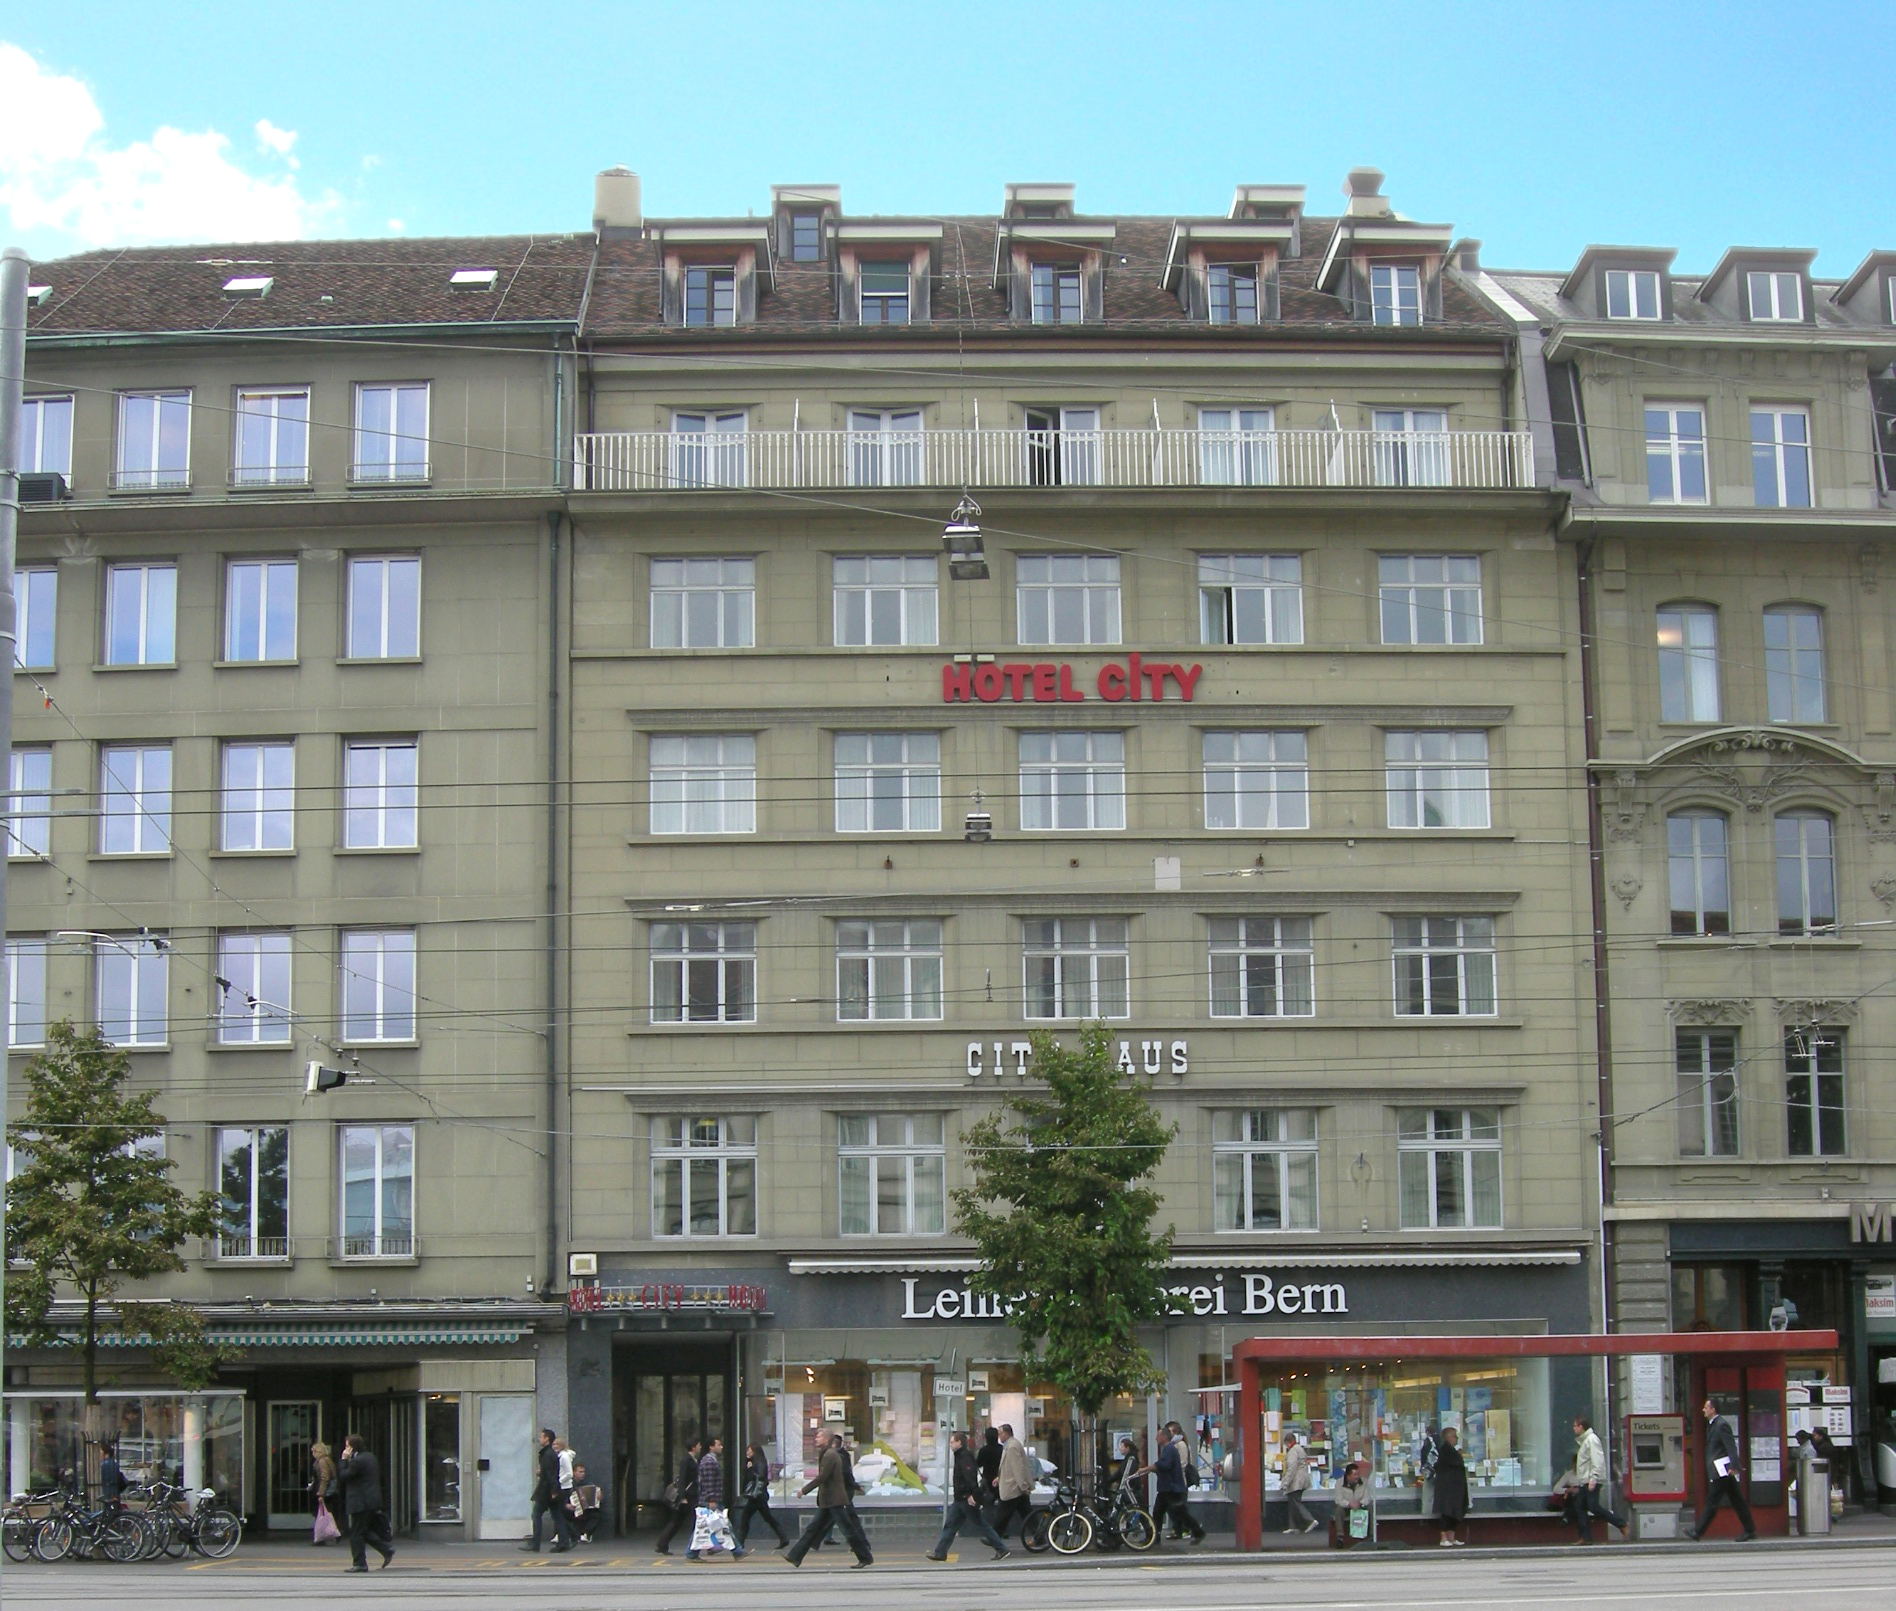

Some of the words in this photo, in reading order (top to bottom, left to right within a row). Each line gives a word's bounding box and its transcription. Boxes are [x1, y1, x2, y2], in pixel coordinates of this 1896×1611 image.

[942, 663, 1085, 703] HOTEL
[641, 1283, 685, 1310] CITY
[1241, 1273, 1349, 1315] Bern
[938, 1383, 963, 1393] Hotel
[1633, 1422, 1660, 1431] Tickets
